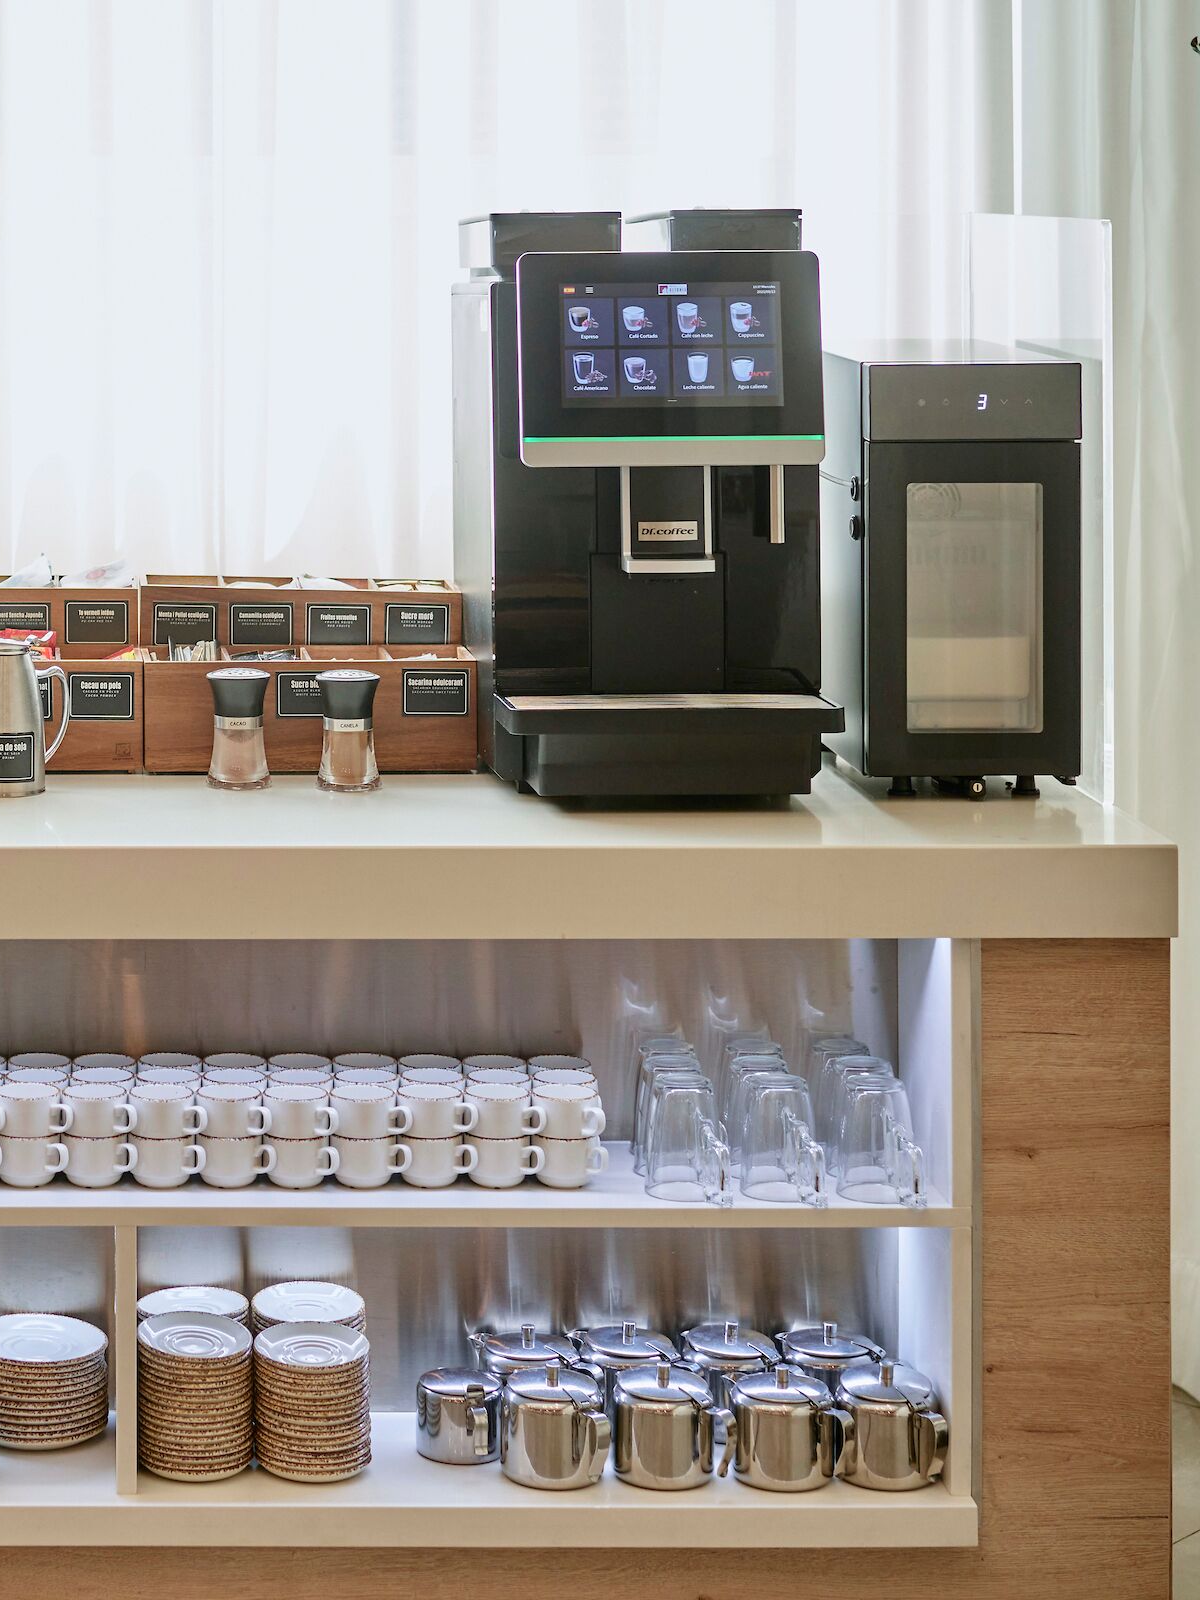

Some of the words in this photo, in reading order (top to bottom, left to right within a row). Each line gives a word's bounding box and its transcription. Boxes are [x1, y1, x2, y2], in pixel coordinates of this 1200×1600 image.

[977, 394, 987, 410] 3
[401, 611, 417, 620] Sucre
[81, 681, 99, 689] Cacau
[291, 680, 310, 688] Sucre
[5, 743, 13, 751] de
[14, 741, 27, 751] soja
